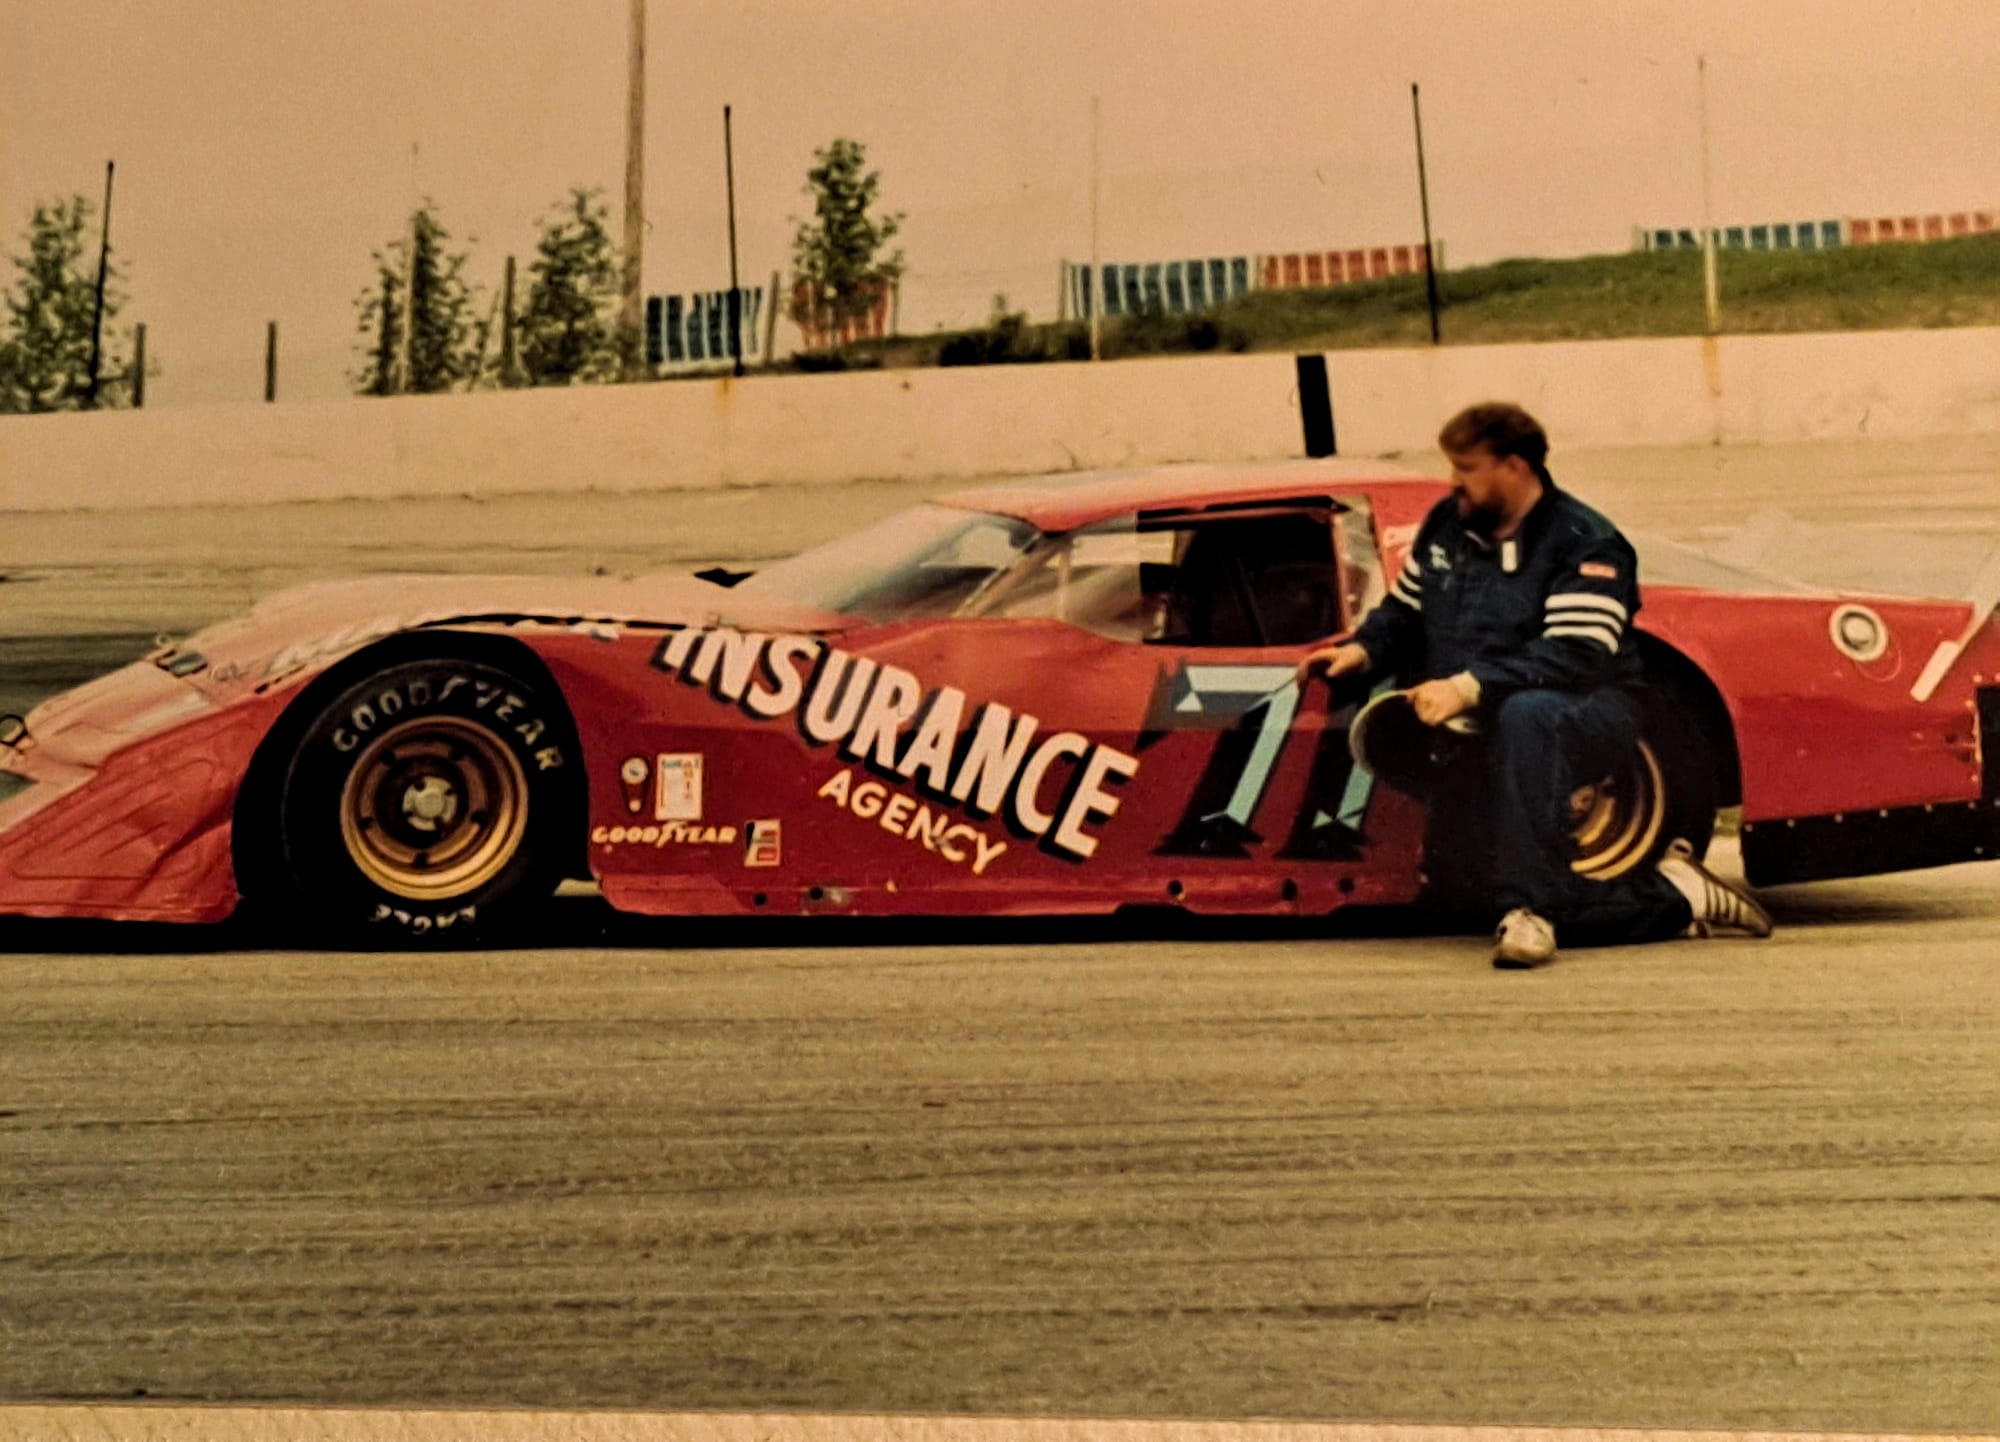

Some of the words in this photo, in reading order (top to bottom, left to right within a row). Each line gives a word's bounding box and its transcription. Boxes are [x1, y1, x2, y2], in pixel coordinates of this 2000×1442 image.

[332, 676, 564, 771] GOODYEAR
[652, 627, 1140, 860] INSURANCE
[591, 821, 738, 848] GOODYEAR
[818, 769, 1008, 876] AGENCY
